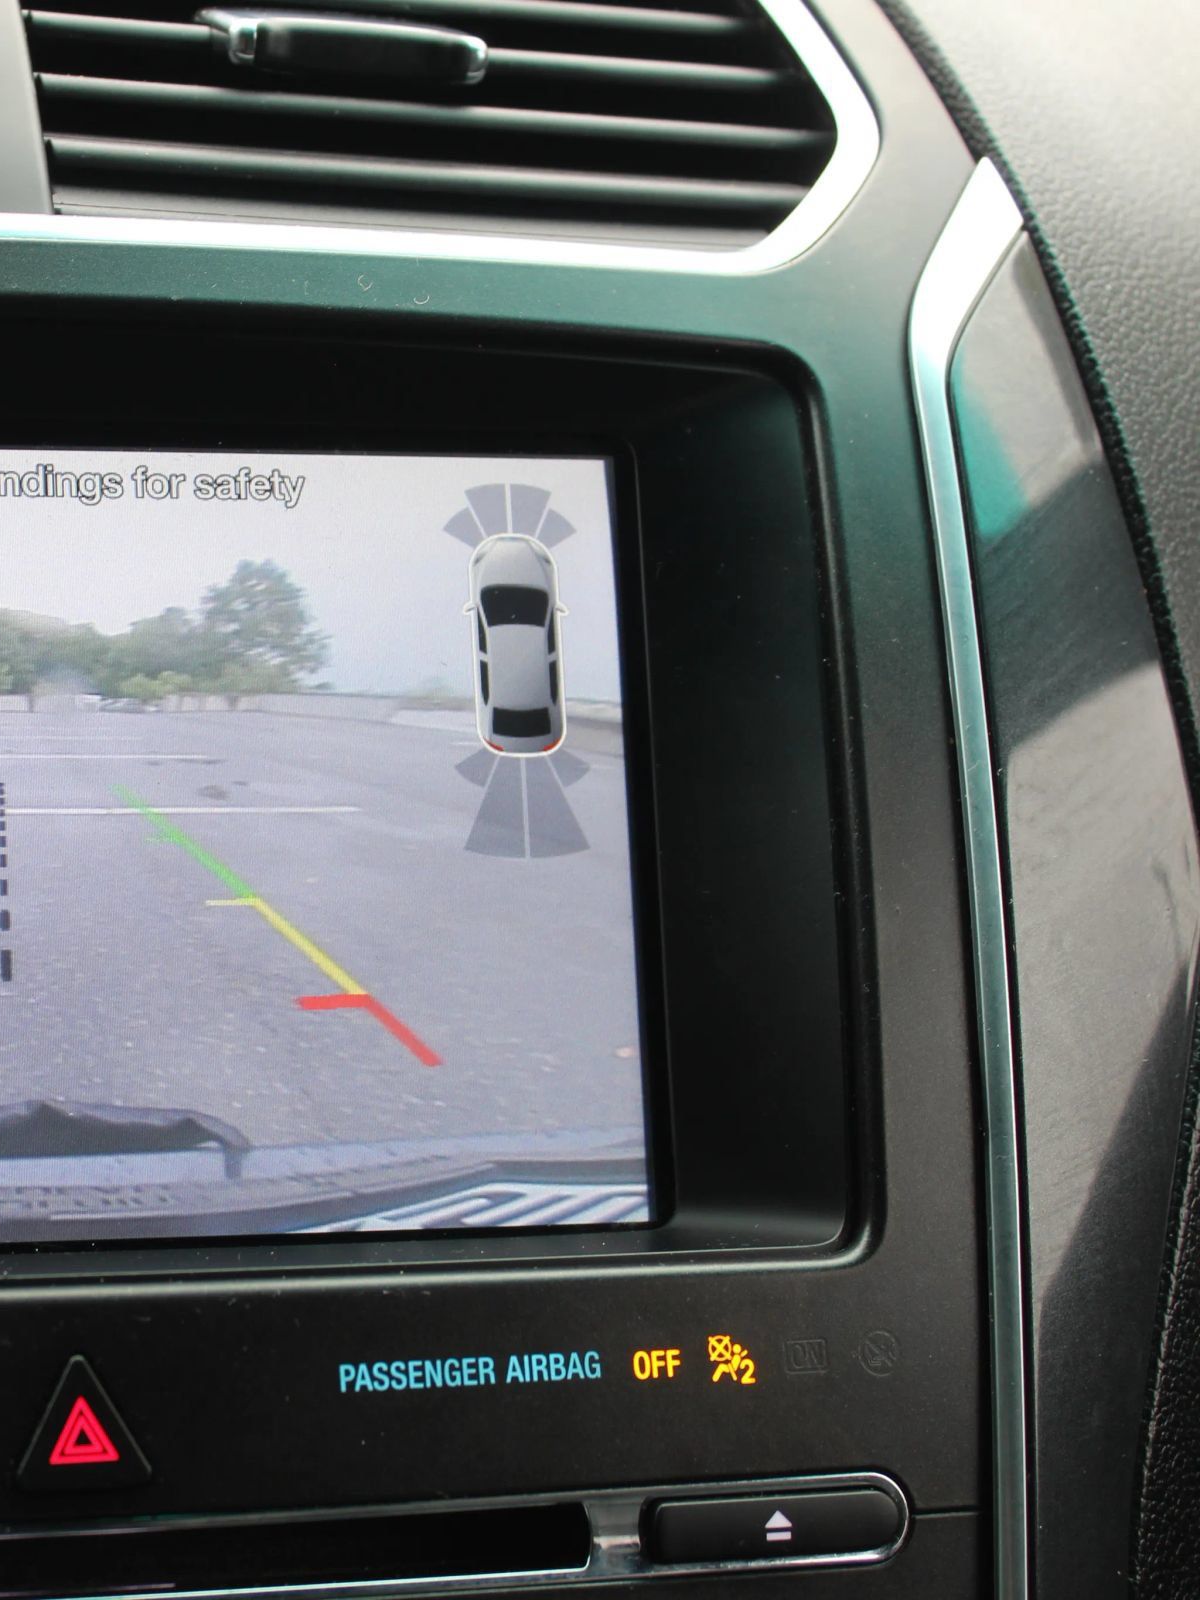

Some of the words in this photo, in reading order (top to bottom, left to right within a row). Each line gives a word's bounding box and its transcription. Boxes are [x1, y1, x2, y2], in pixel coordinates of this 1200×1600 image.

[131, 465, 186, 499] for
[193, 467, 306, 508] safety
[338, 1356, 496, 1393] PASSENGER
[505, 1350, 601, 1384] AIRBAG
[632, 1348, 681, 1380] OFF
